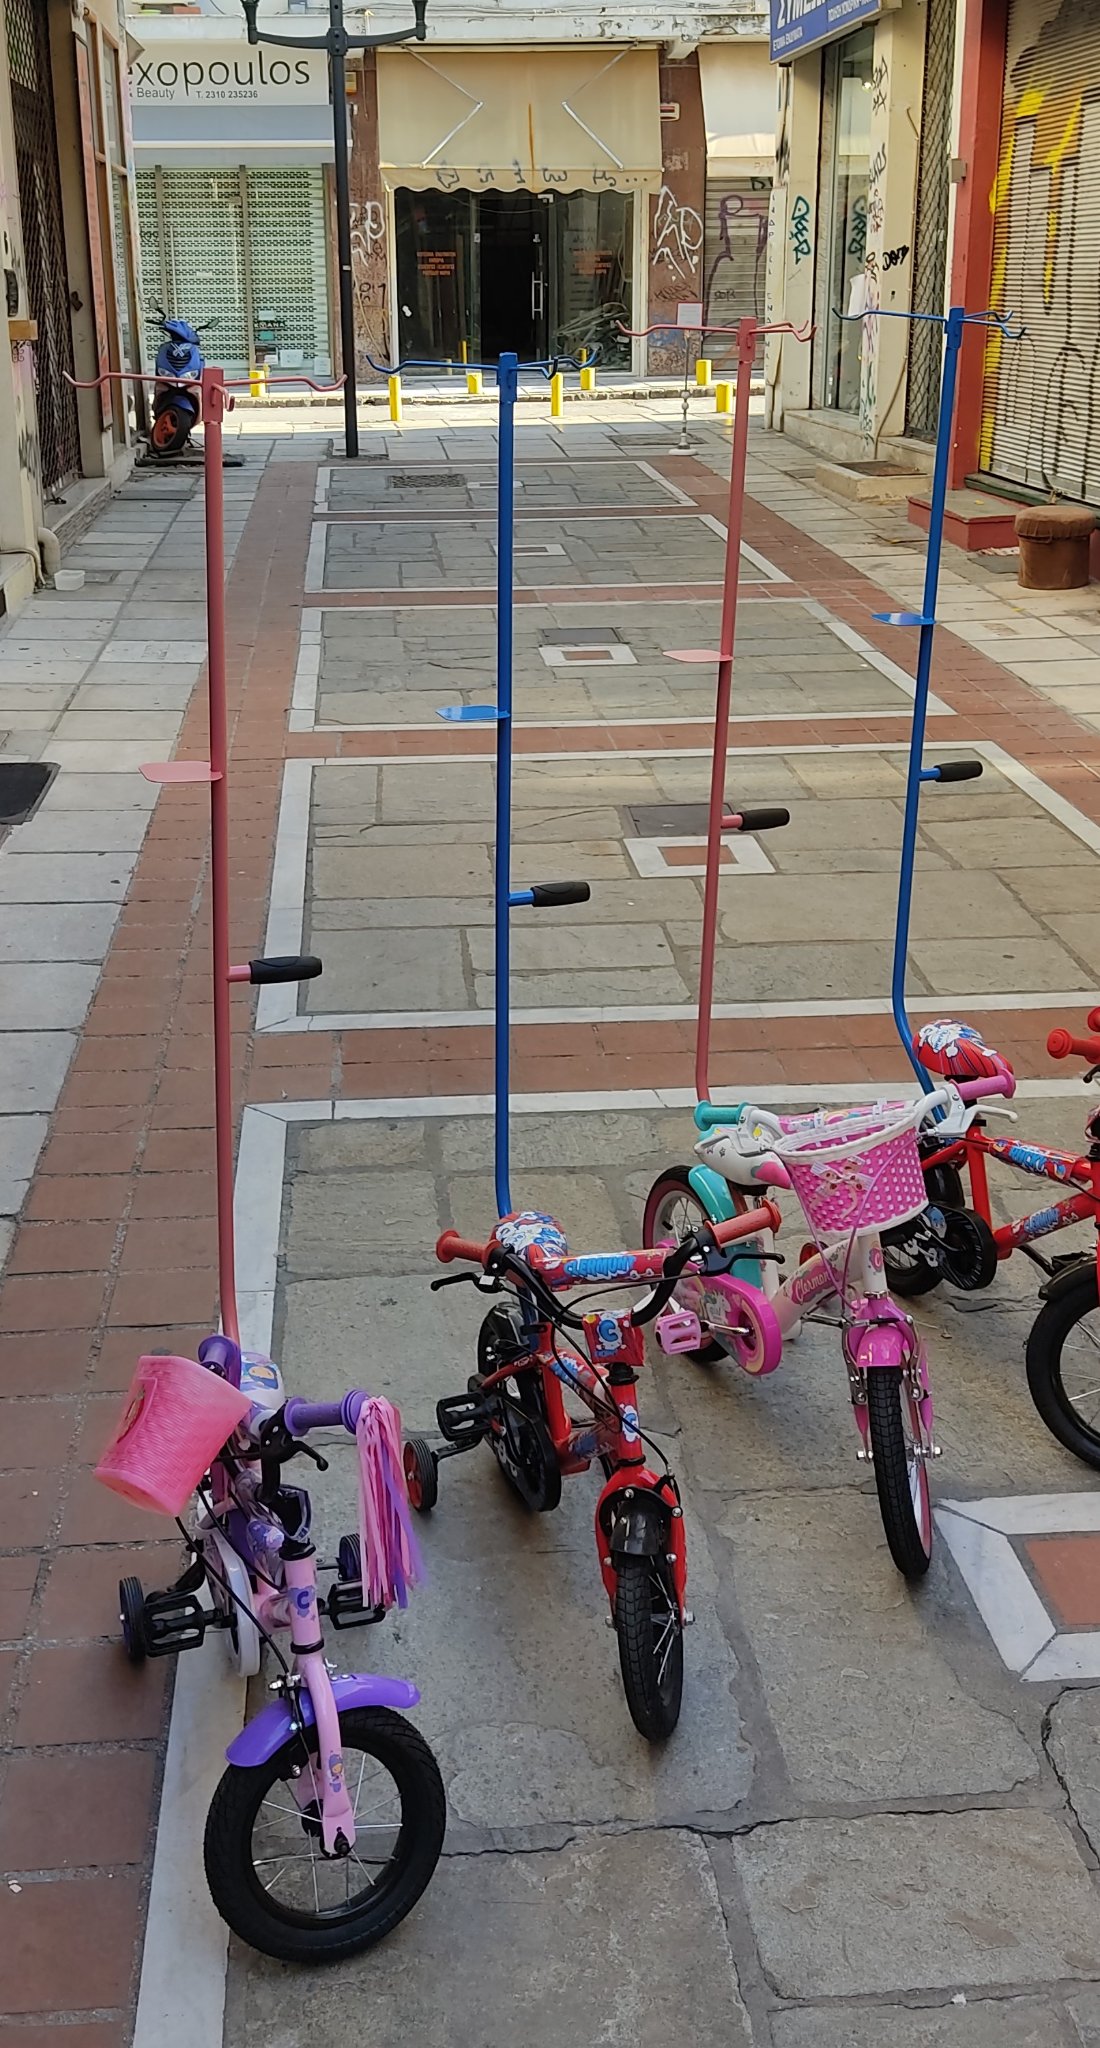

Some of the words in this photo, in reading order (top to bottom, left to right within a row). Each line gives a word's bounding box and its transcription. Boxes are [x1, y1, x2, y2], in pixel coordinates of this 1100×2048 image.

[128, 50, 310, 97] xopoulos
[136, 87, 175, 101] Beauty
[205, 90, 226, 99] 2310
[228, 90, 258, 99] 235236
[296, 1590, 310, 1610] C
